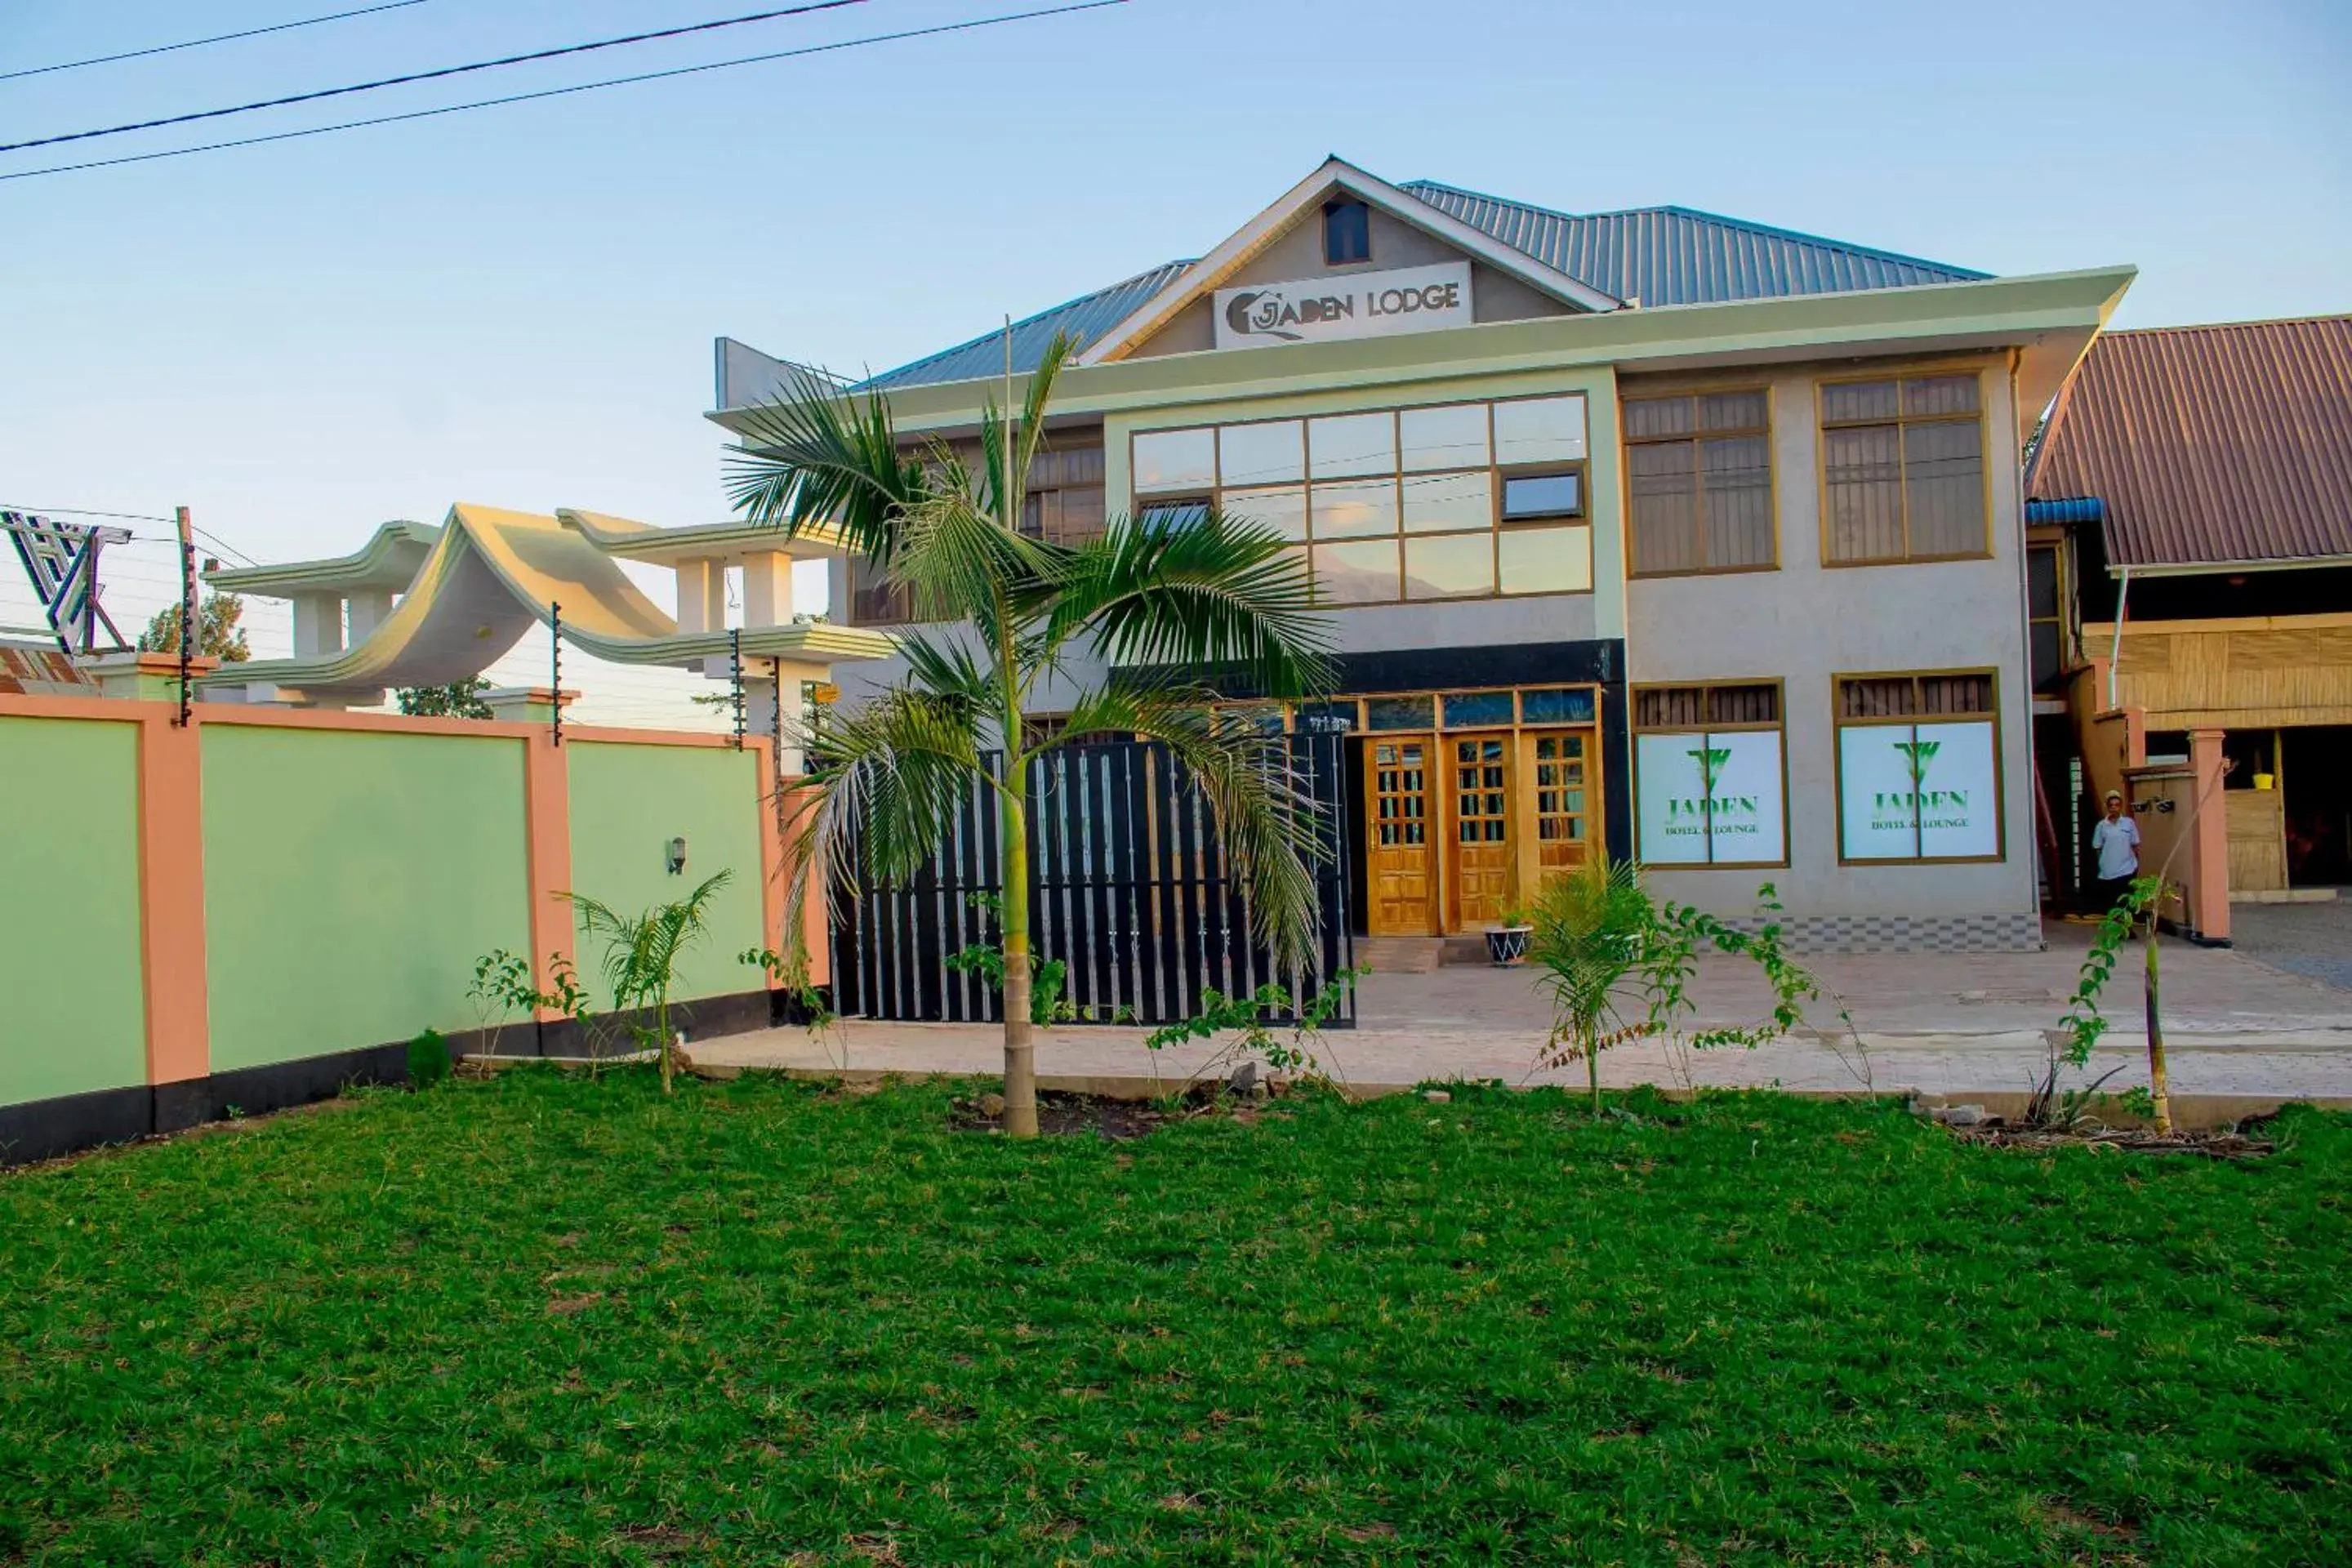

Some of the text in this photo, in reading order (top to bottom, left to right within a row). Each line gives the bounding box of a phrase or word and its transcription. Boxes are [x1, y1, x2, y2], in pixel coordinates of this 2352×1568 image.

[1367, 282, 1460, 317] LODGE
[1664, 796, 1758, 822] JADEN
[1873, 790, 1969, 815] JADEN
